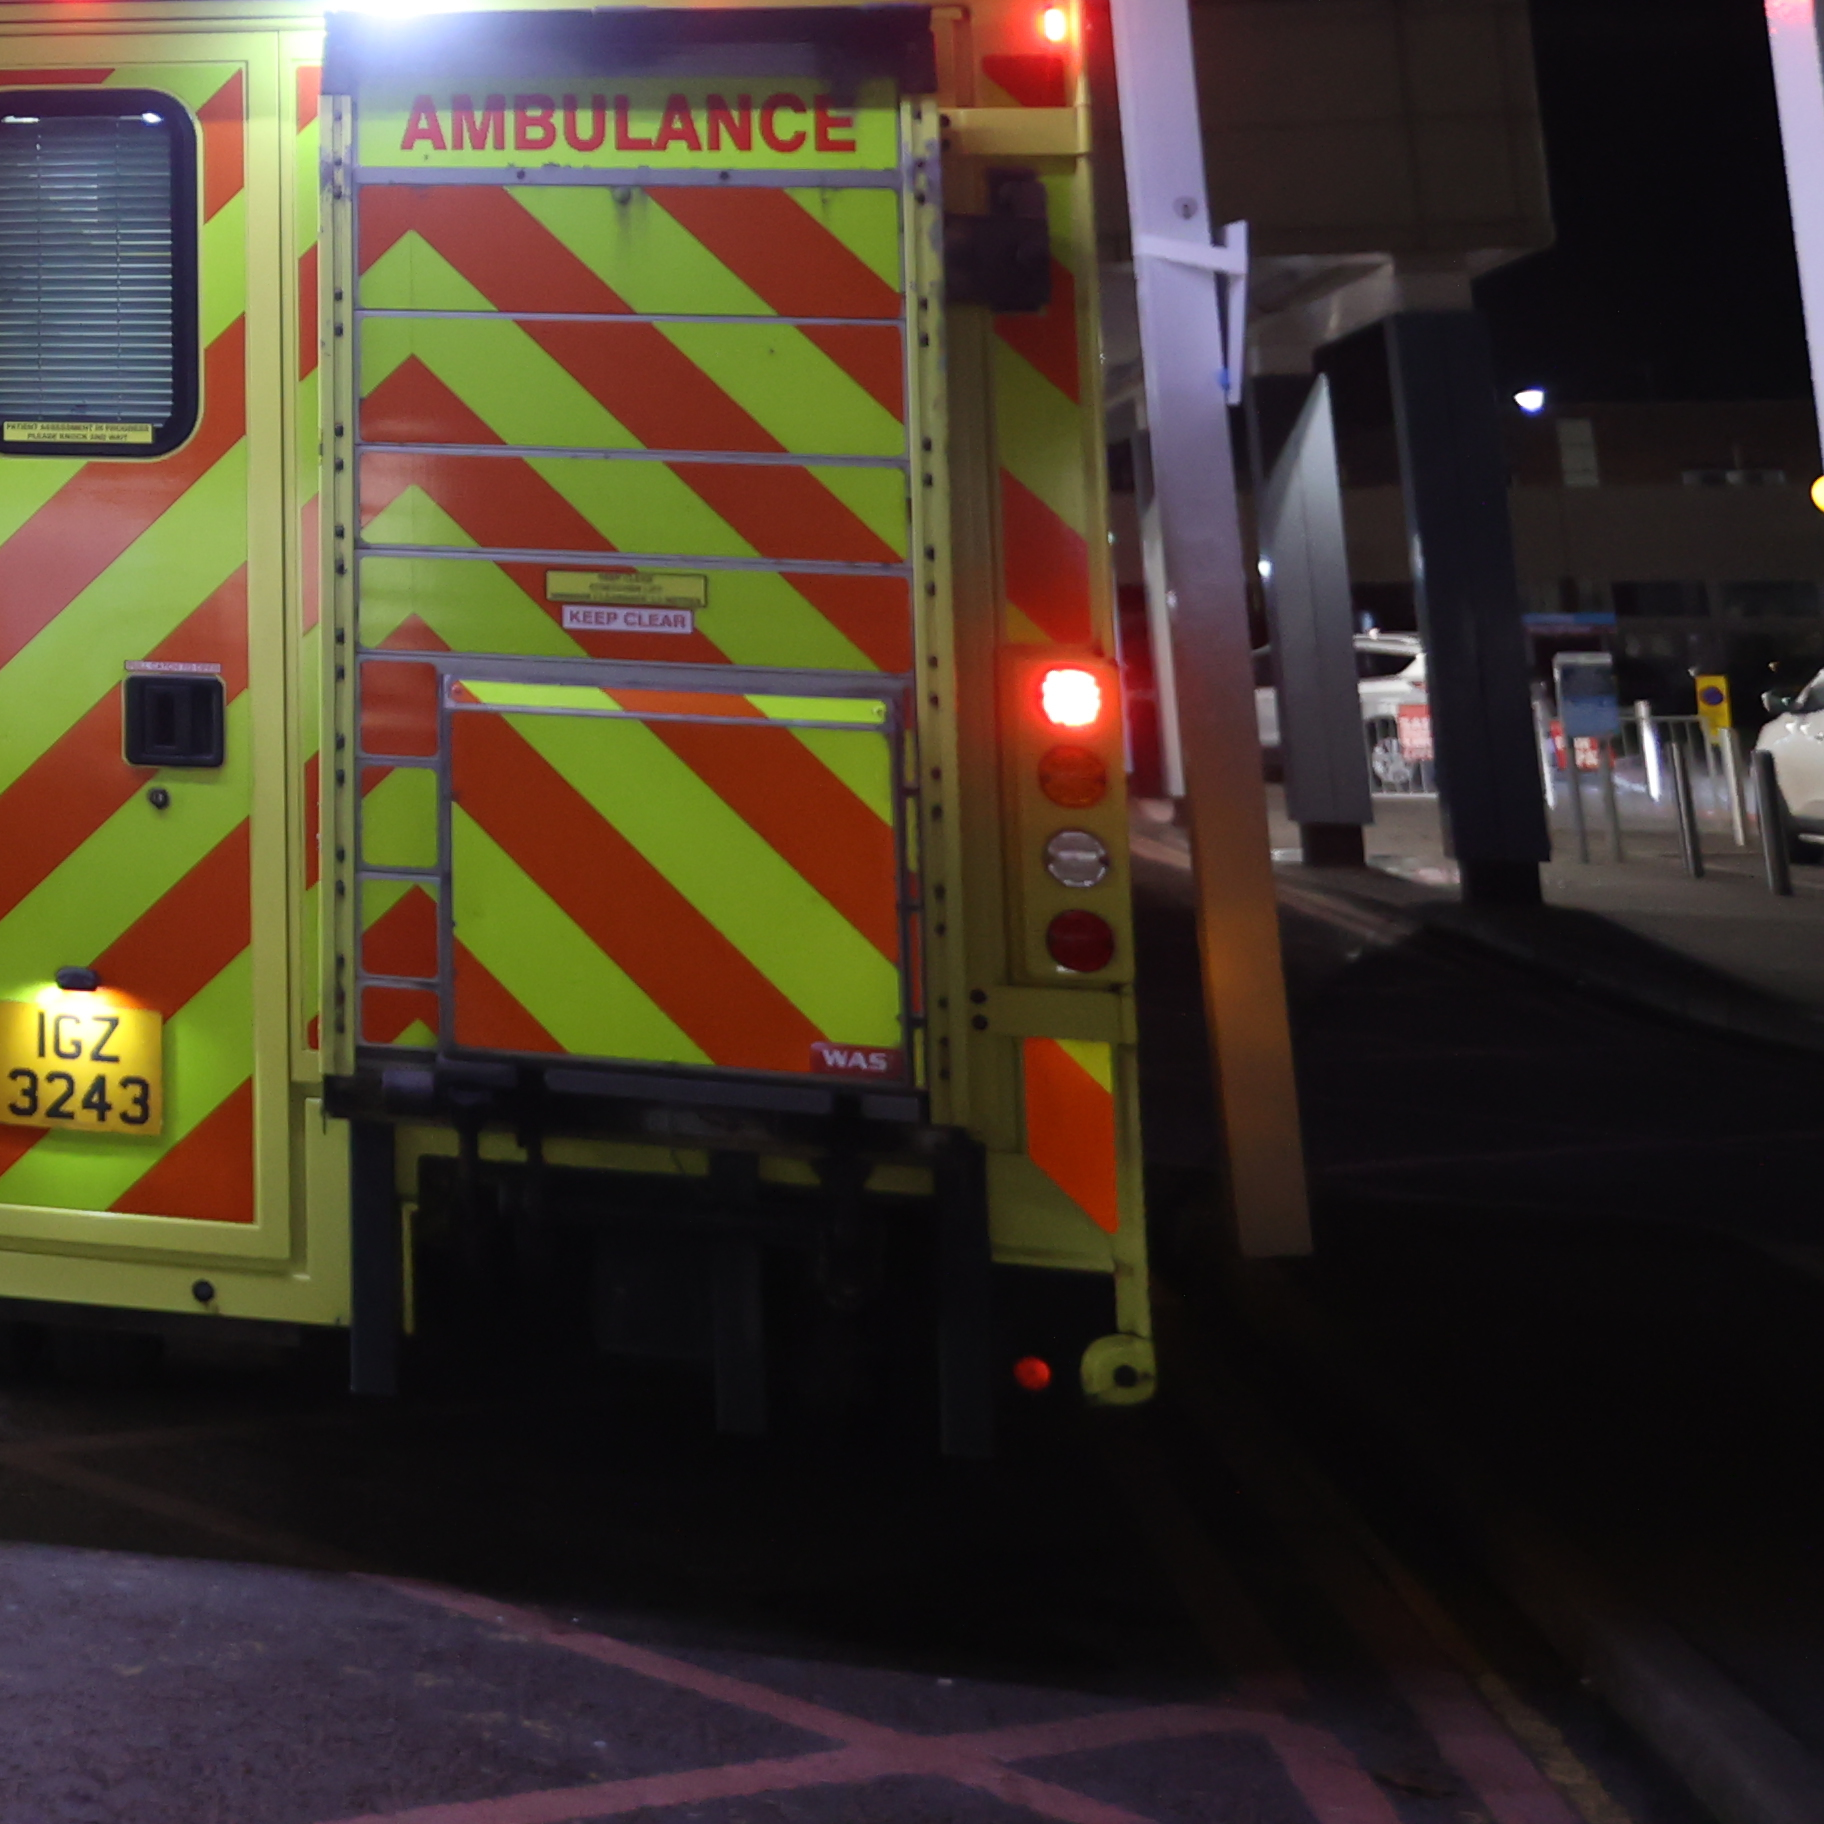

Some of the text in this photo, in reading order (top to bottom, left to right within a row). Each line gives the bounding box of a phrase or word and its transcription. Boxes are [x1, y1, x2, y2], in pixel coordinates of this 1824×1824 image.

[400, 92, 857, 153] AMBULANCE
[569, 609, 686, 629] KEEP CLEAR
[37, 1011, 121, 1063] IGZ
[822, 1048, 888, 1071] WAS
[8, 1067, 151, 1125] 3243
